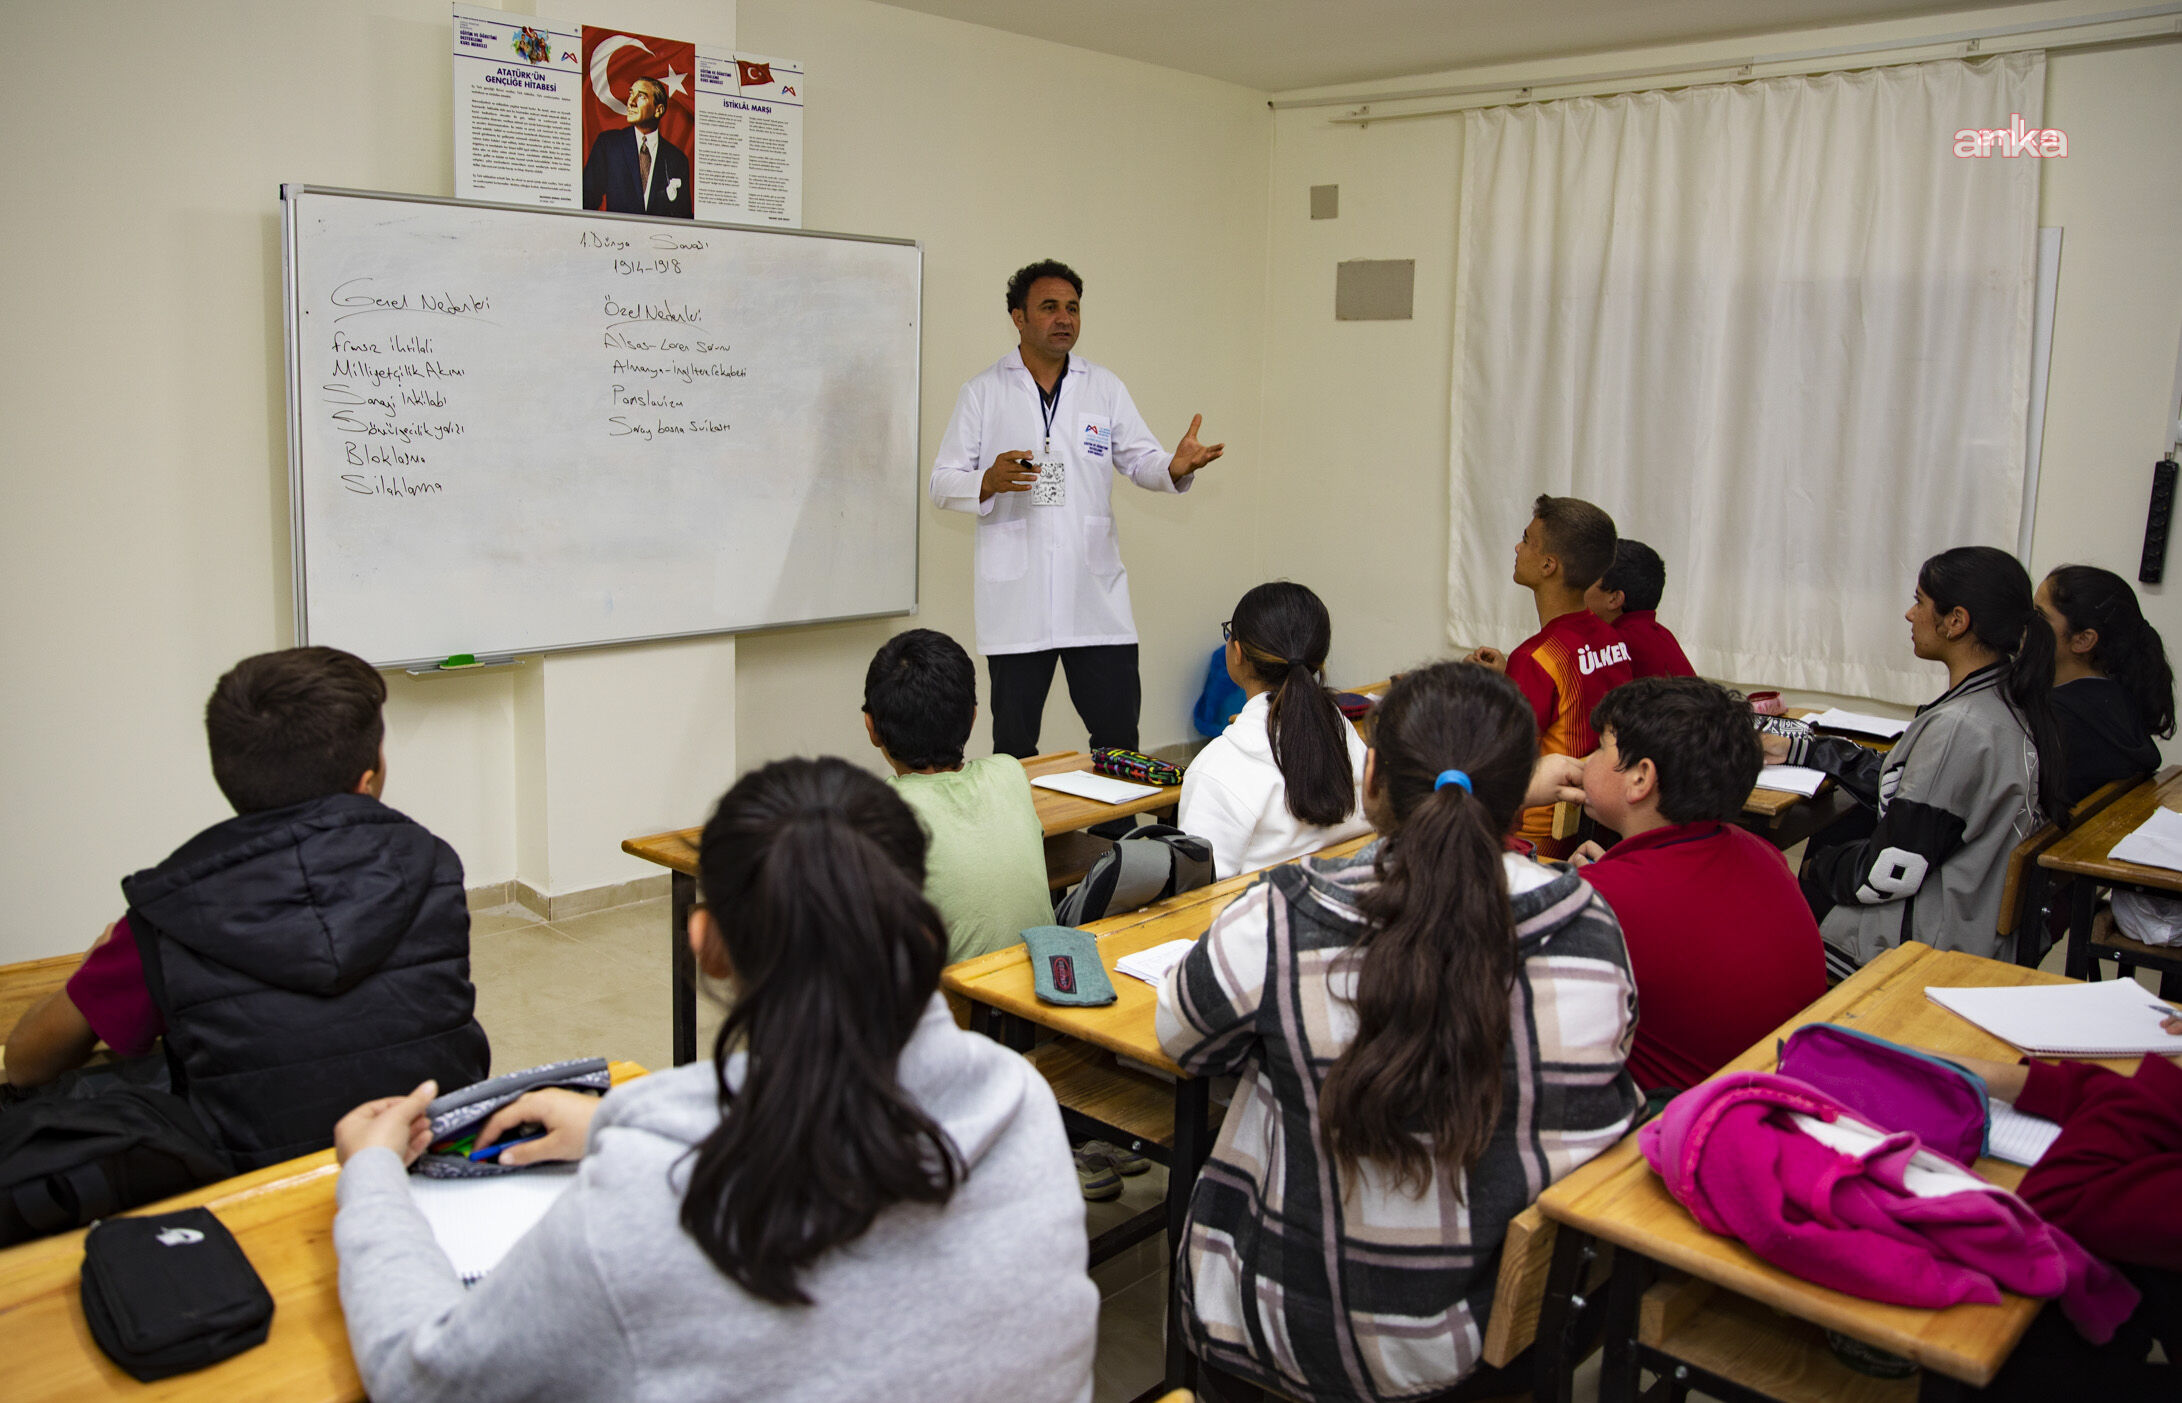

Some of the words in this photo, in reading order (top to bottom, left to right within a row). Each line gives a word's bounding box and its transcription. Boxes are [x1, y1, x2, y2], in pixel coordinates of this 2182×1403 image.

[496, 66, 546, 82] ATATÜRK'ÜN
[485, 74, 523, 88] GENÇLİĞE
[524, 79, 557, 93] HİTABESİ
[751, 104, 772, 114] MARŞI
[614, 258, 682, 276] 1914-1918
[604, 294, 641, 319] Özel
[1577, 641, 1632, 676] ÜLKER
